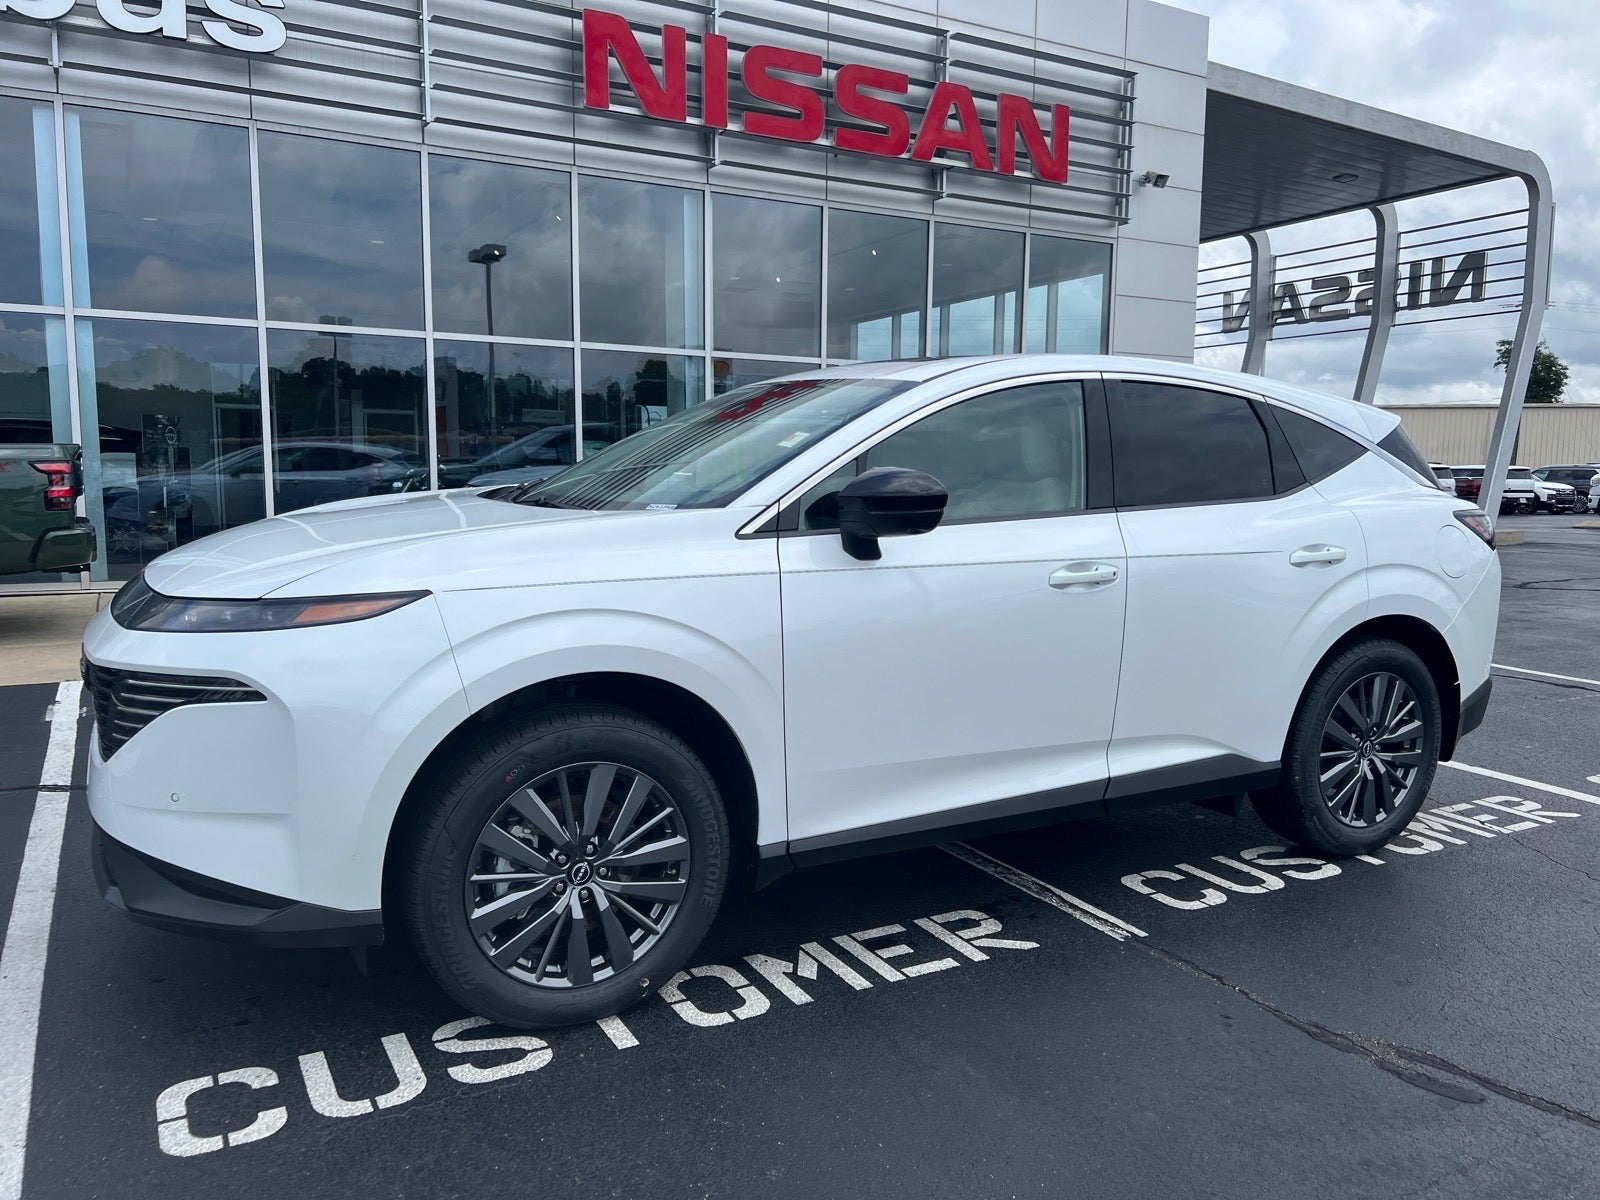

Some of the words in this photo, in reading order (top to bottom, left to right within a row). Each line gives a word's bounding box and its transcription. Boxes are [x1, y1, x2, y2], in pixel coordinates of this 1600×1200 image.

[0, 0, 287, 53] us
[582, 8, 1070, 184] NISSAN
[1120, 795, 1581, 911] CUSOMER
